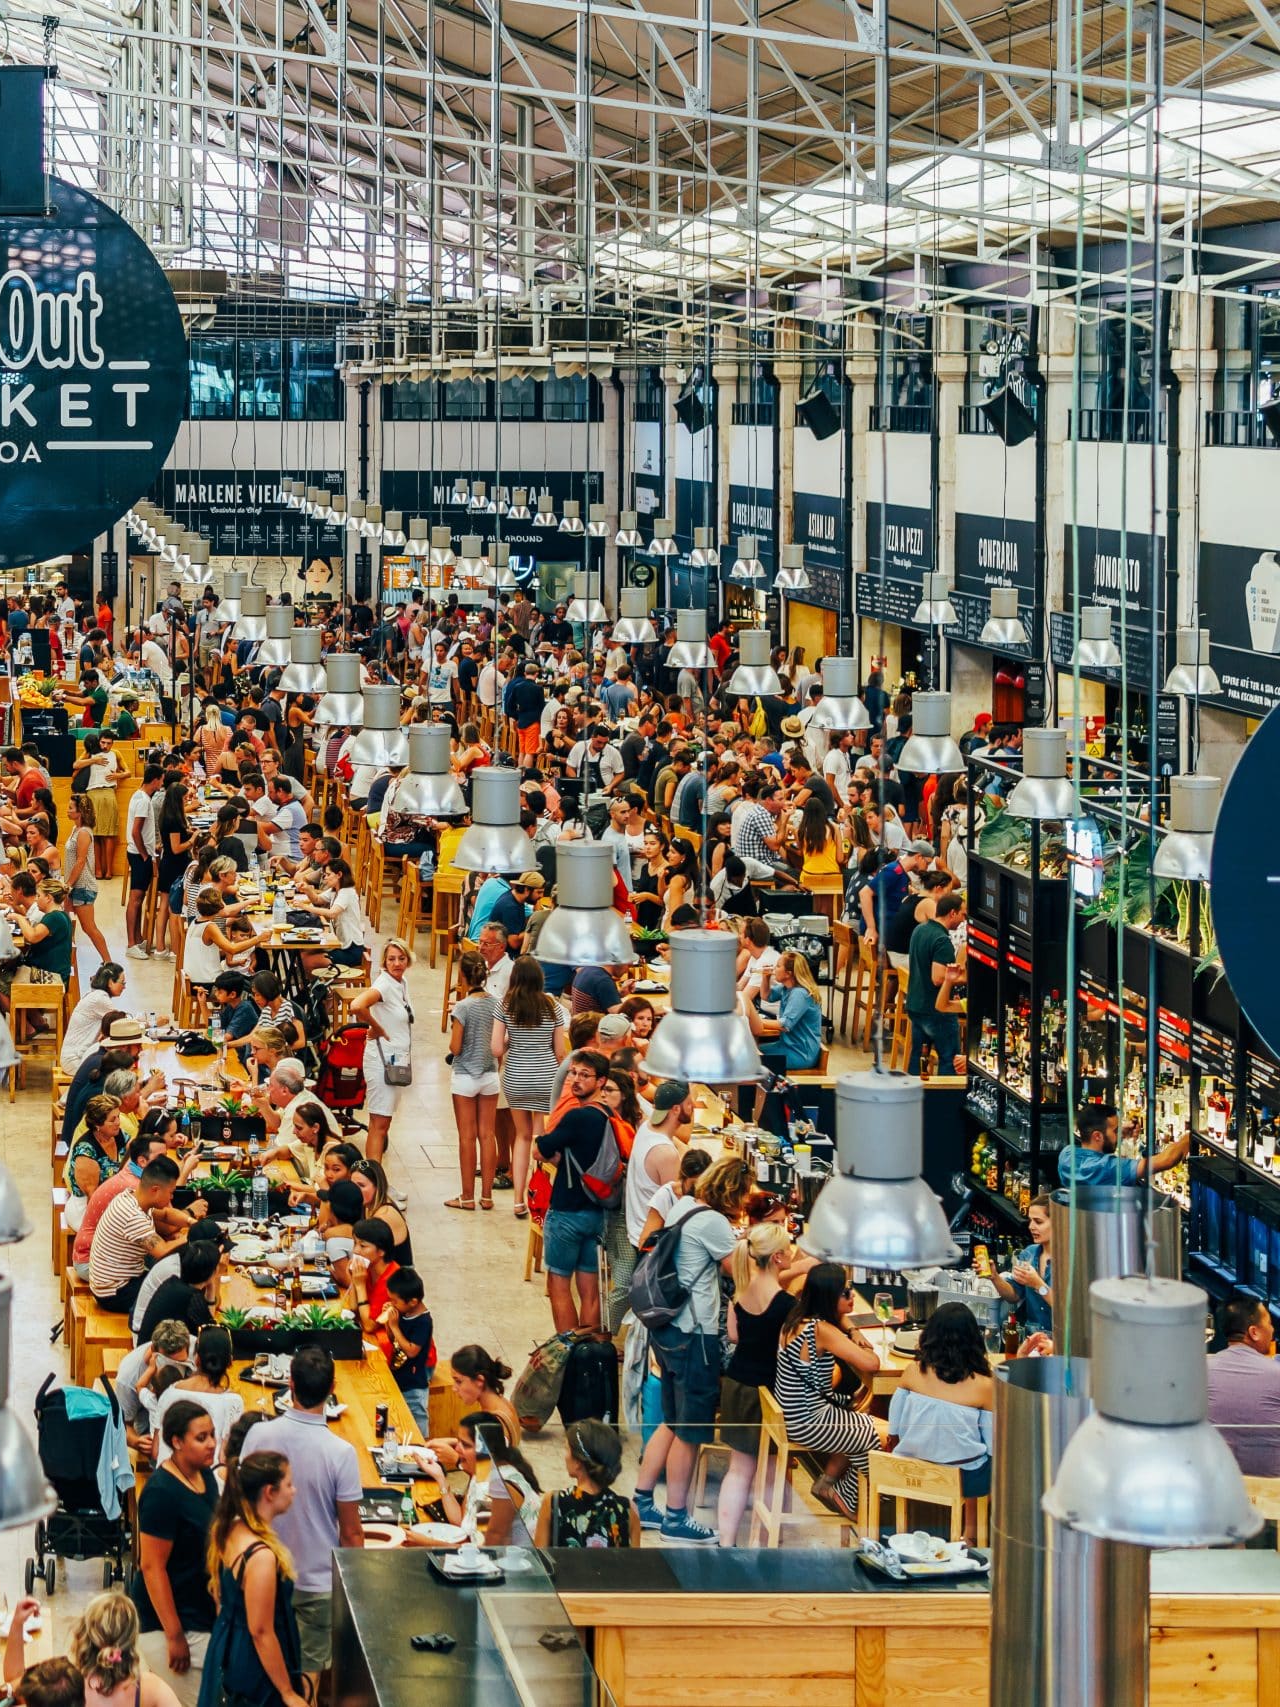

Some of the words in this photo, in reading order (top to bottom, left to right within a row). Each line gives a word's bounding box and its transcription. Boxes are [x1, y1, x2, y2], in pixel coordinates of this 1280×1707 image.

[175, 484, 243, 504] MARLENE
[824, 515, 835, 541] LAB
[505, 535, 543, 543] AROUND
[900, 526, 905, 553] A
[906, 527, 923, 556] PEZZI
[978, 537, 1018, 573] CONFRARIA
[1222, 674, 1239, 687] ESPERE
[1240, 676, 1249, 689] ATÉ
[1250, 680, 1260, 691] TER
[1228, 688, 1240, 700] PARA
